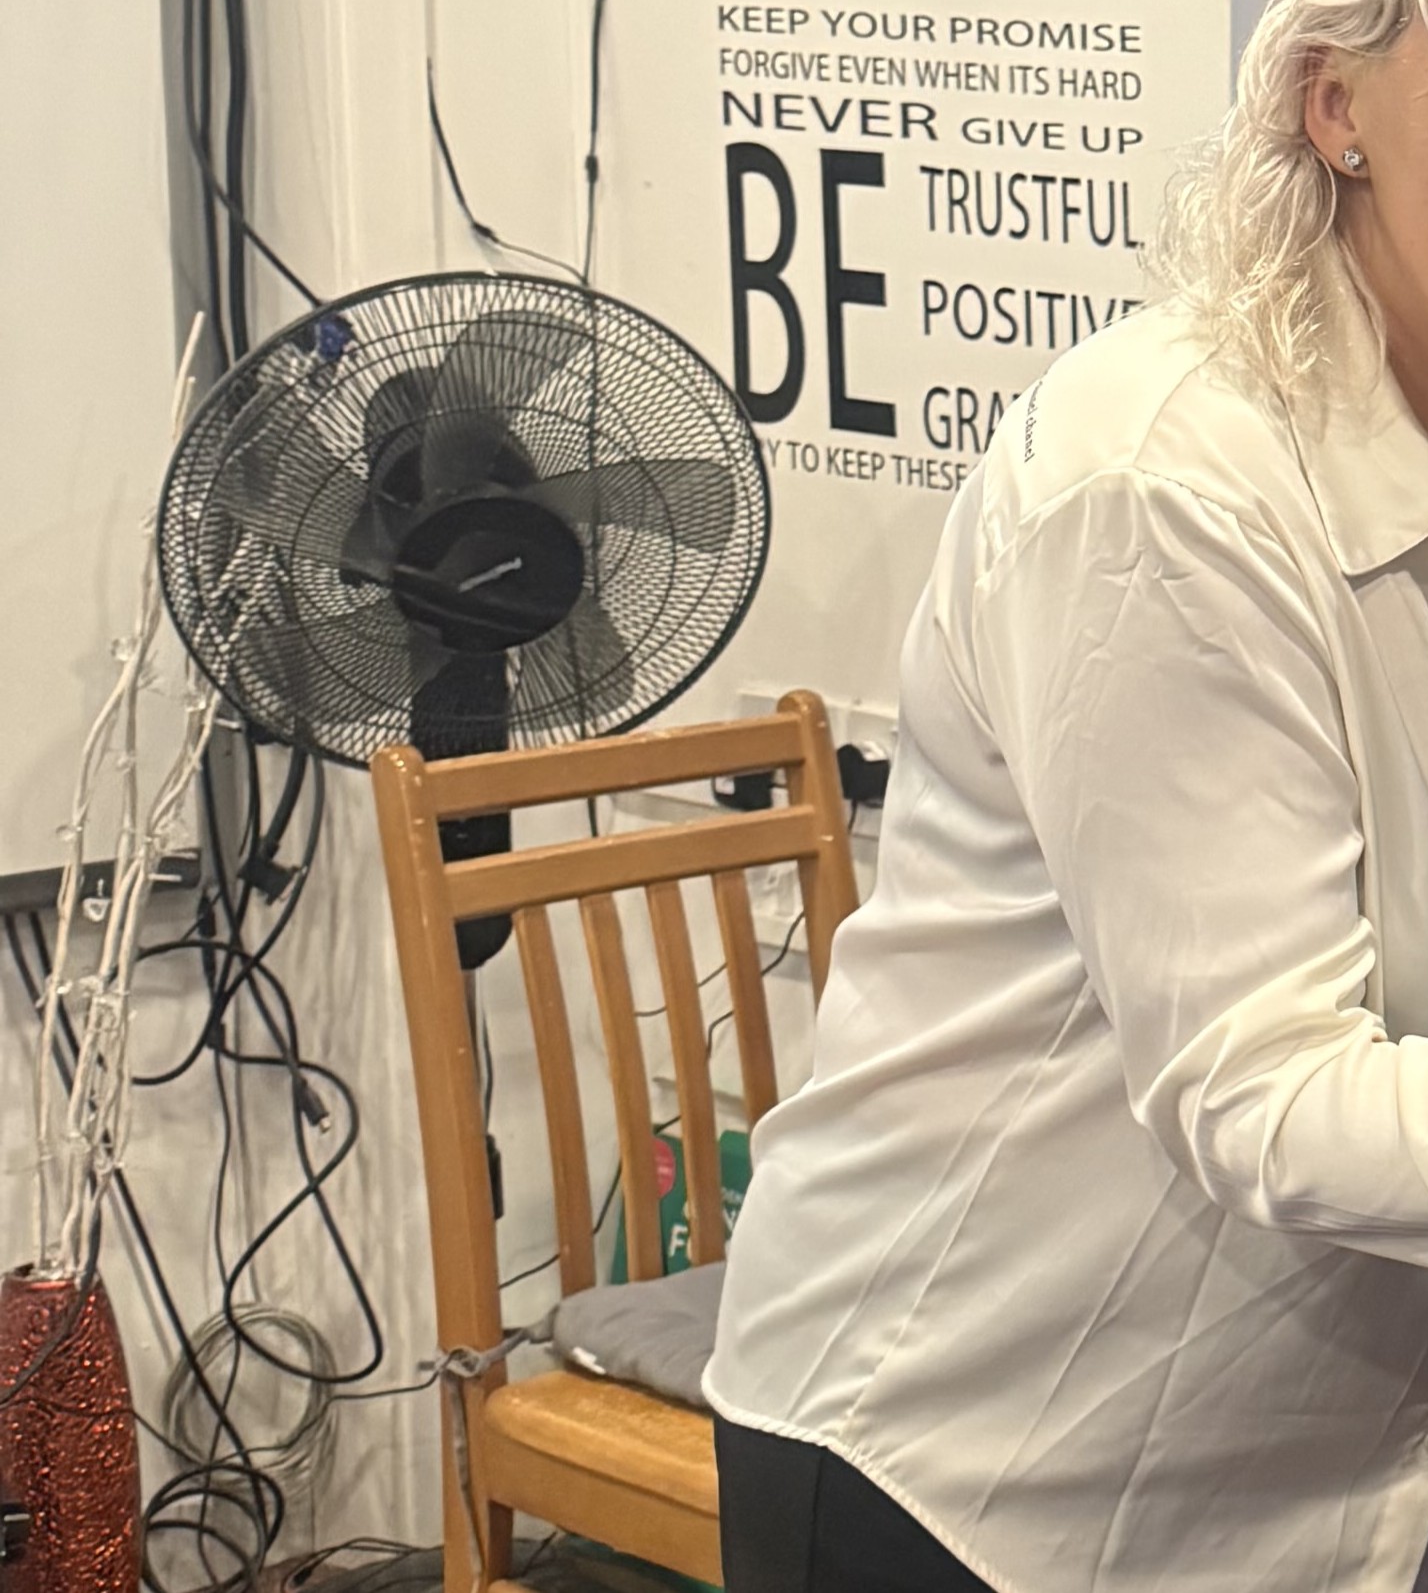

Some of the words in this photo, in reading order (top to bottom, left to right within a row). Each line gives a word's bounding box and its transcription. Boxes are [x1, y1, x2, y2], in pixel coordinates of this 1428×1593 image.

[718, 5, 810, 36] KEEP
[820, 9, 937, 43] YOUR
[949, 16, 1142, 54] PROMISE
[719, 47, 831, 82] FORGIVE
[838, 54, 906, 87] EVEN
[914, 59, 1000, 93] WHEN
[1008, 65, 1050, 96] ITS
[1058, 68, 1142, 101] HARD
[721, 90, 939, 142] NEVER
[961, 117, 1066, 151] GIVE
[1081, 124, 1144, 155] UP
[725, 142, 898, 439] BE
[922, 385, 1021, 455] GRA
[785, 440, 820, 473] TO
[826, 446, 886, 481] KEEP
